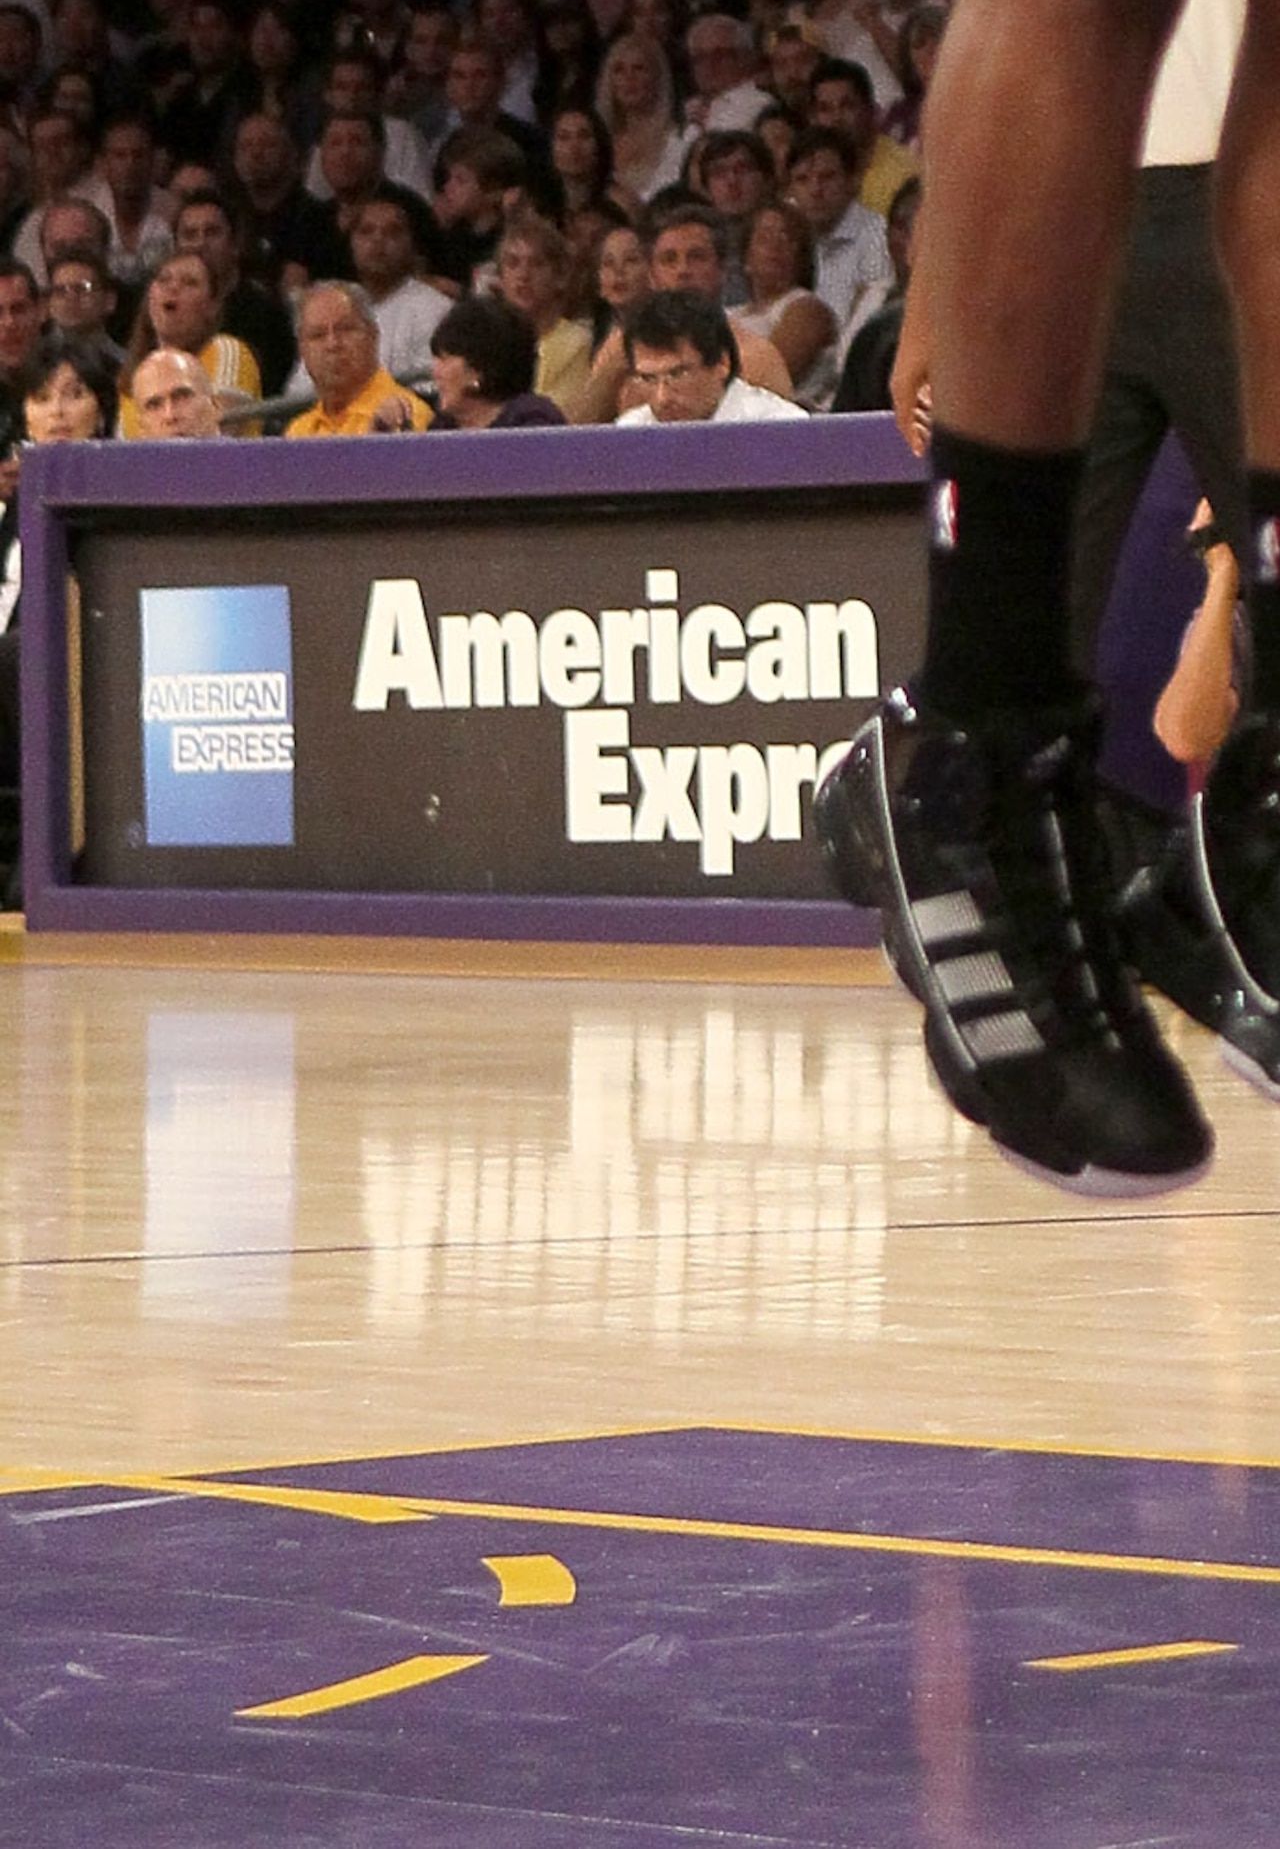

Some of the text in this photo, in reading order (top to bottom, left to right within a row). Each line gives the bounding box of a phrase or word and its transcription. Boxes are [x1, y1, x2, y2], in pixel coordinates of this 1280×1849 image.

[353, 568, 880, 711] American
[147, 680, 284, 714] AMERICAN
[177, 732, 295, 765] EXPRESS
